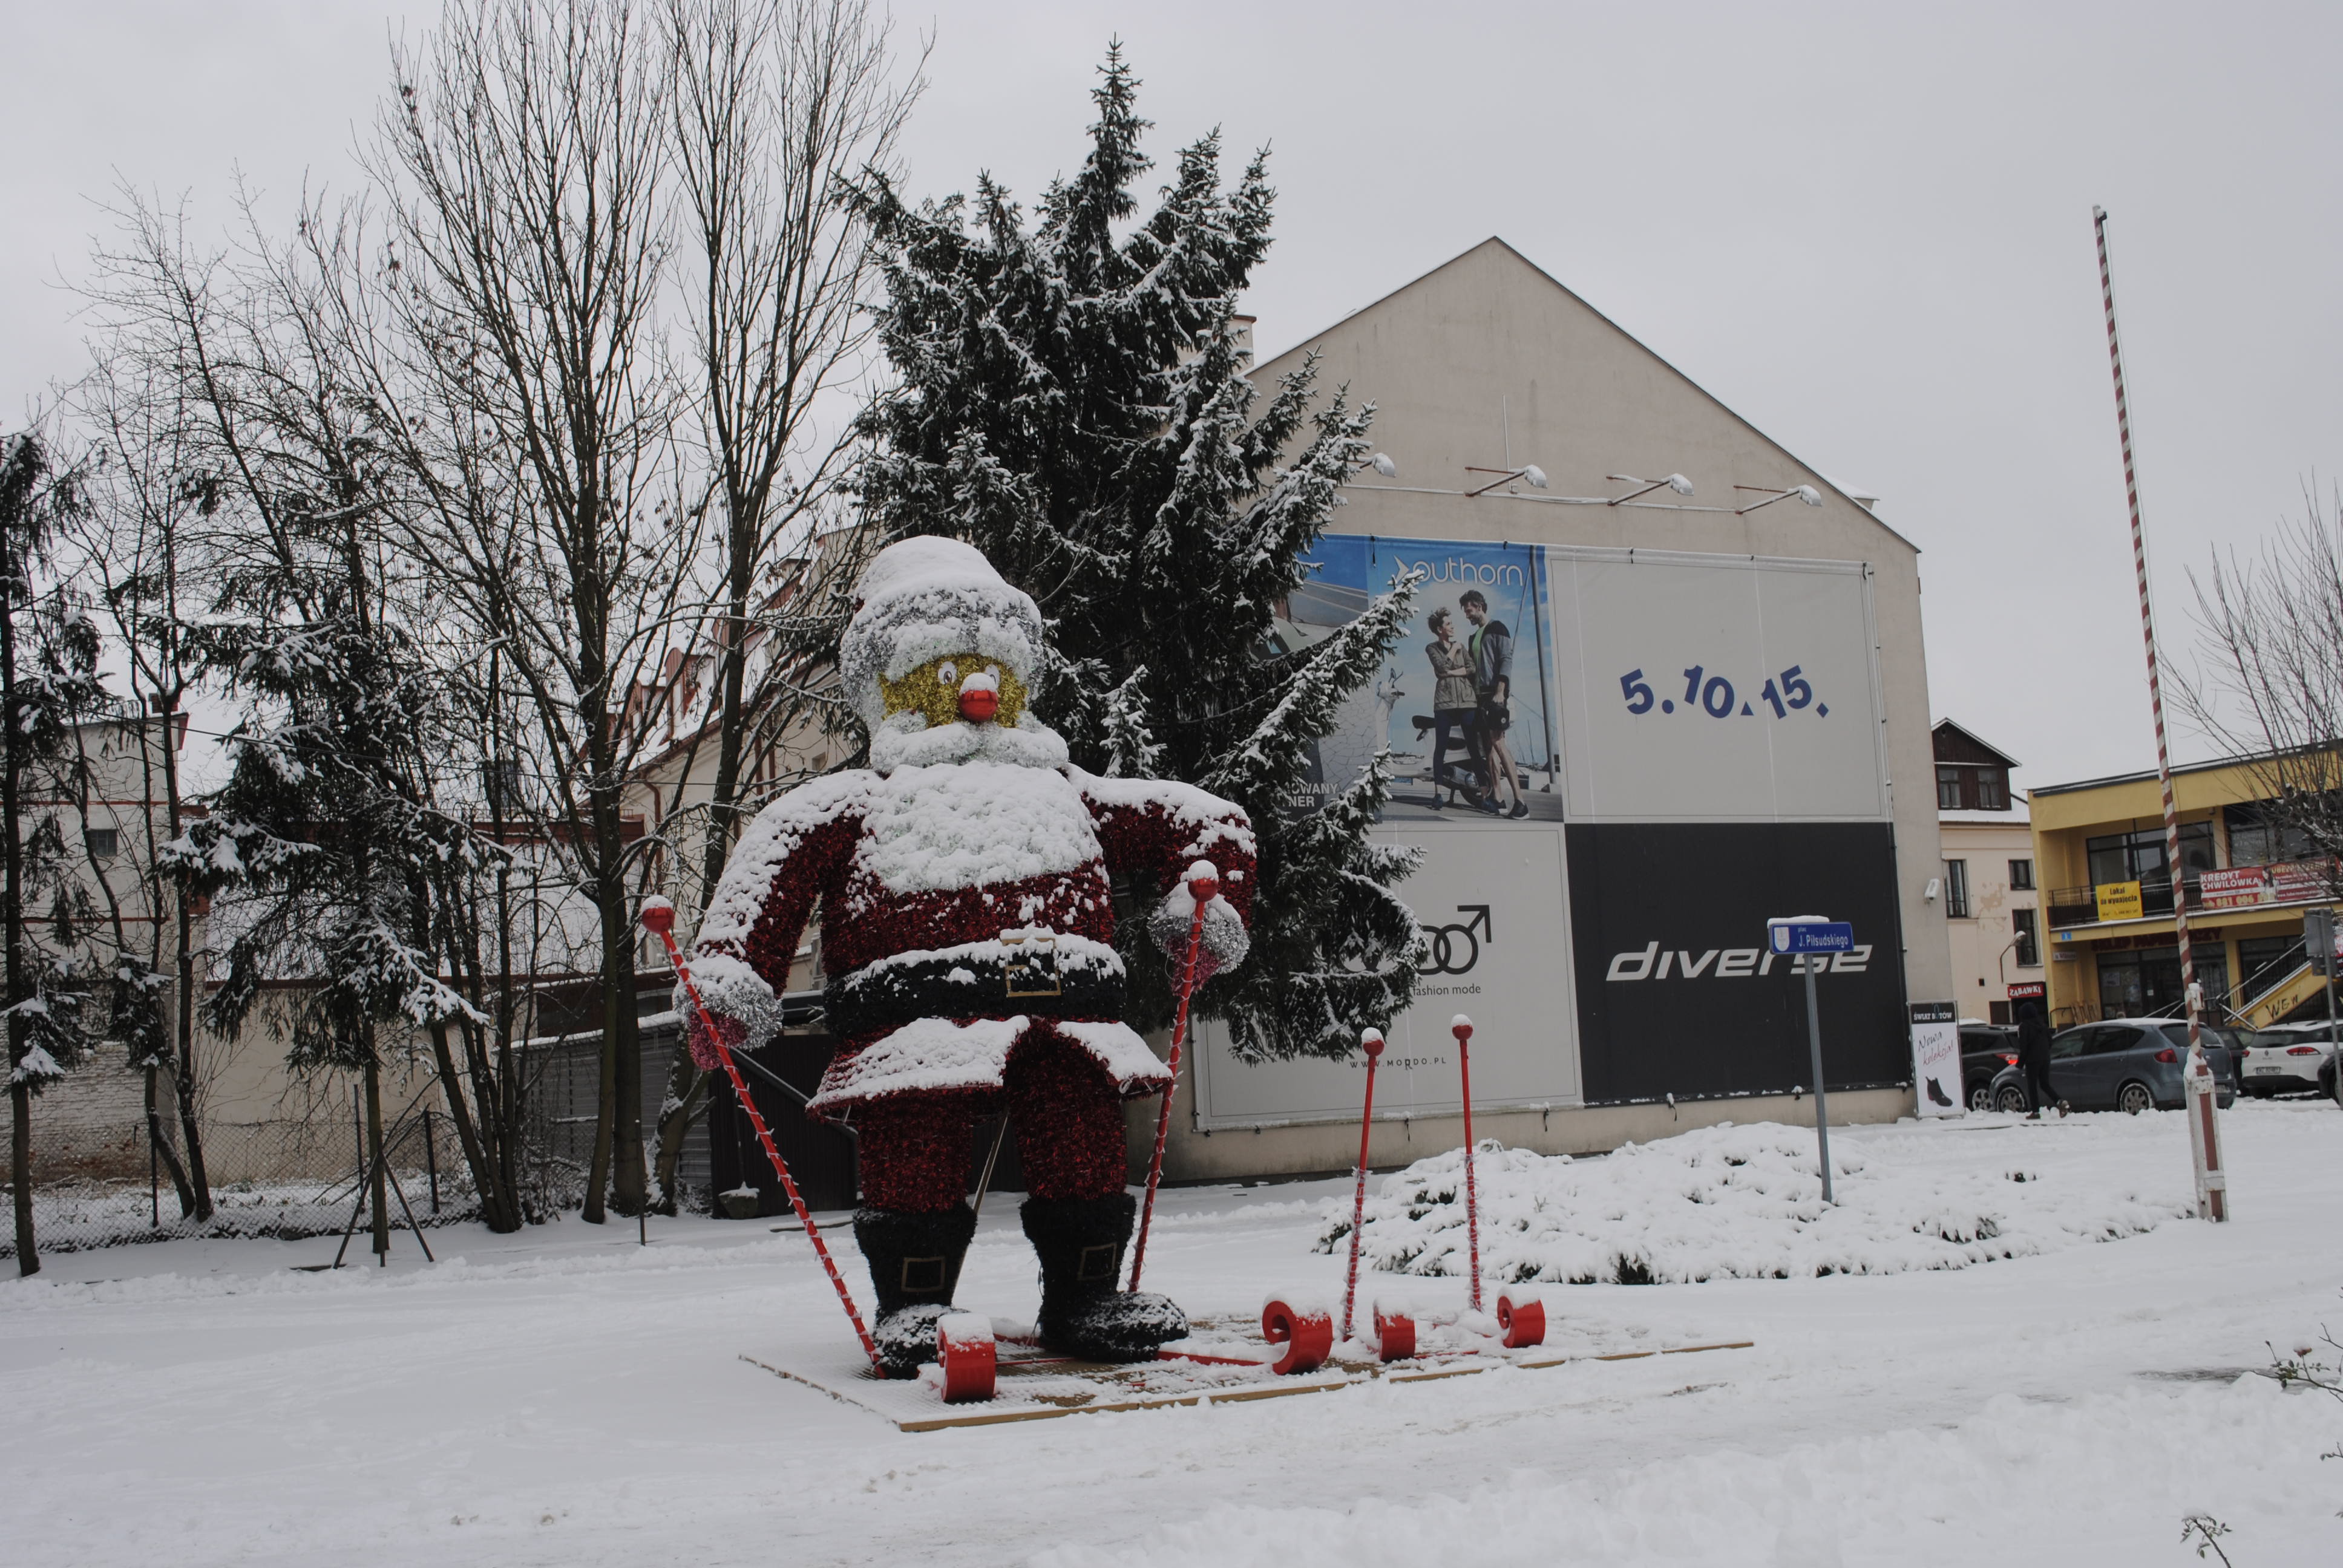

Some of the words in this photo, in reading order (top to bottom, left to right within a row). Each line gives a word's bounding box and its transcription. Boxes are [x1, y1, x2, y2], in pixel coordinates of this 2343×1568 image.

[1619, 665, 1829, 719] 5.10.15.
[2200, 871, 2240, 883] KREDYT
[2201, 877, 2259, 890] CHWILÓWKA
[1798, 935, 1806, 947] J.
[1413, 984, 1449, 996] fashion
[1452, 983, 1481, 995] mode
[2009, 985, 2042, 996] ZABAWKI
[1913, 1011, 1931, 1021] ŚWIAT
[1918, 1031, 1942, 1052] Nowa
